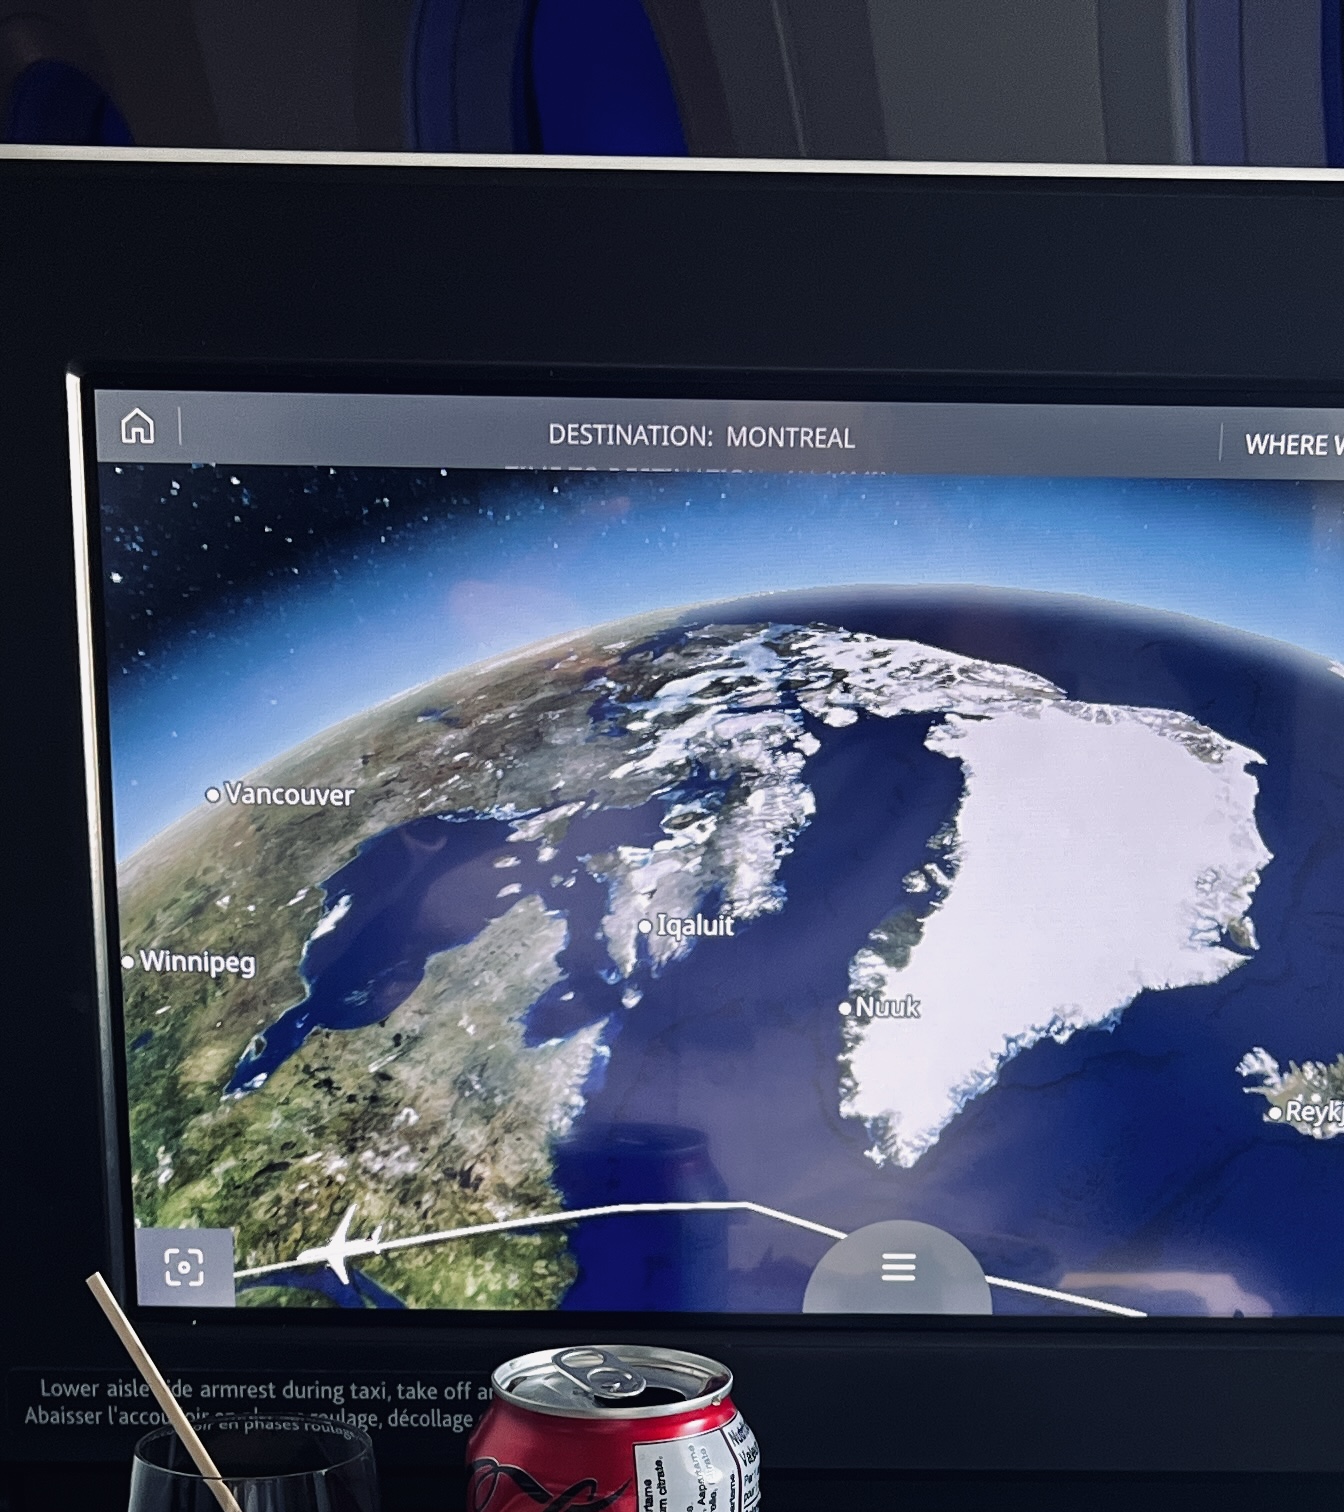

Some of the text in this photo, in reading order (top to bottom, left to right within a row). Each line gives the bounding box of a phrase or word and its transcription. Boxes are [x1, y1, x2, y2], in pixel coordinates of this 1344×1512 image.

[548, 423, 856, 448] DESTINATION: MONTREAL
[1245, 433, 1329, 456] WHERE
[223, 781, 355, 806] Vancouver
[657, 913, 734, 940] Iqaluit
[140, 949, 256, 978] Winnipeg
[856, 995, 921, 1018] Nuuk
[40, 1379, 100, 1398] Lower
[106, 1379, 150, 1398] aisle
[200, 1381, 276, 1398] armrest
[282, 1380, 345, 1405] during
[350, 1381, 392, 1402] taxi,
[397, 1381, 438, 1400] take
[444, 1381, 472, 1400] off
[24, 1405, 103, 1425] Abaisser
[388, 1409, 474, 1433] décollage
